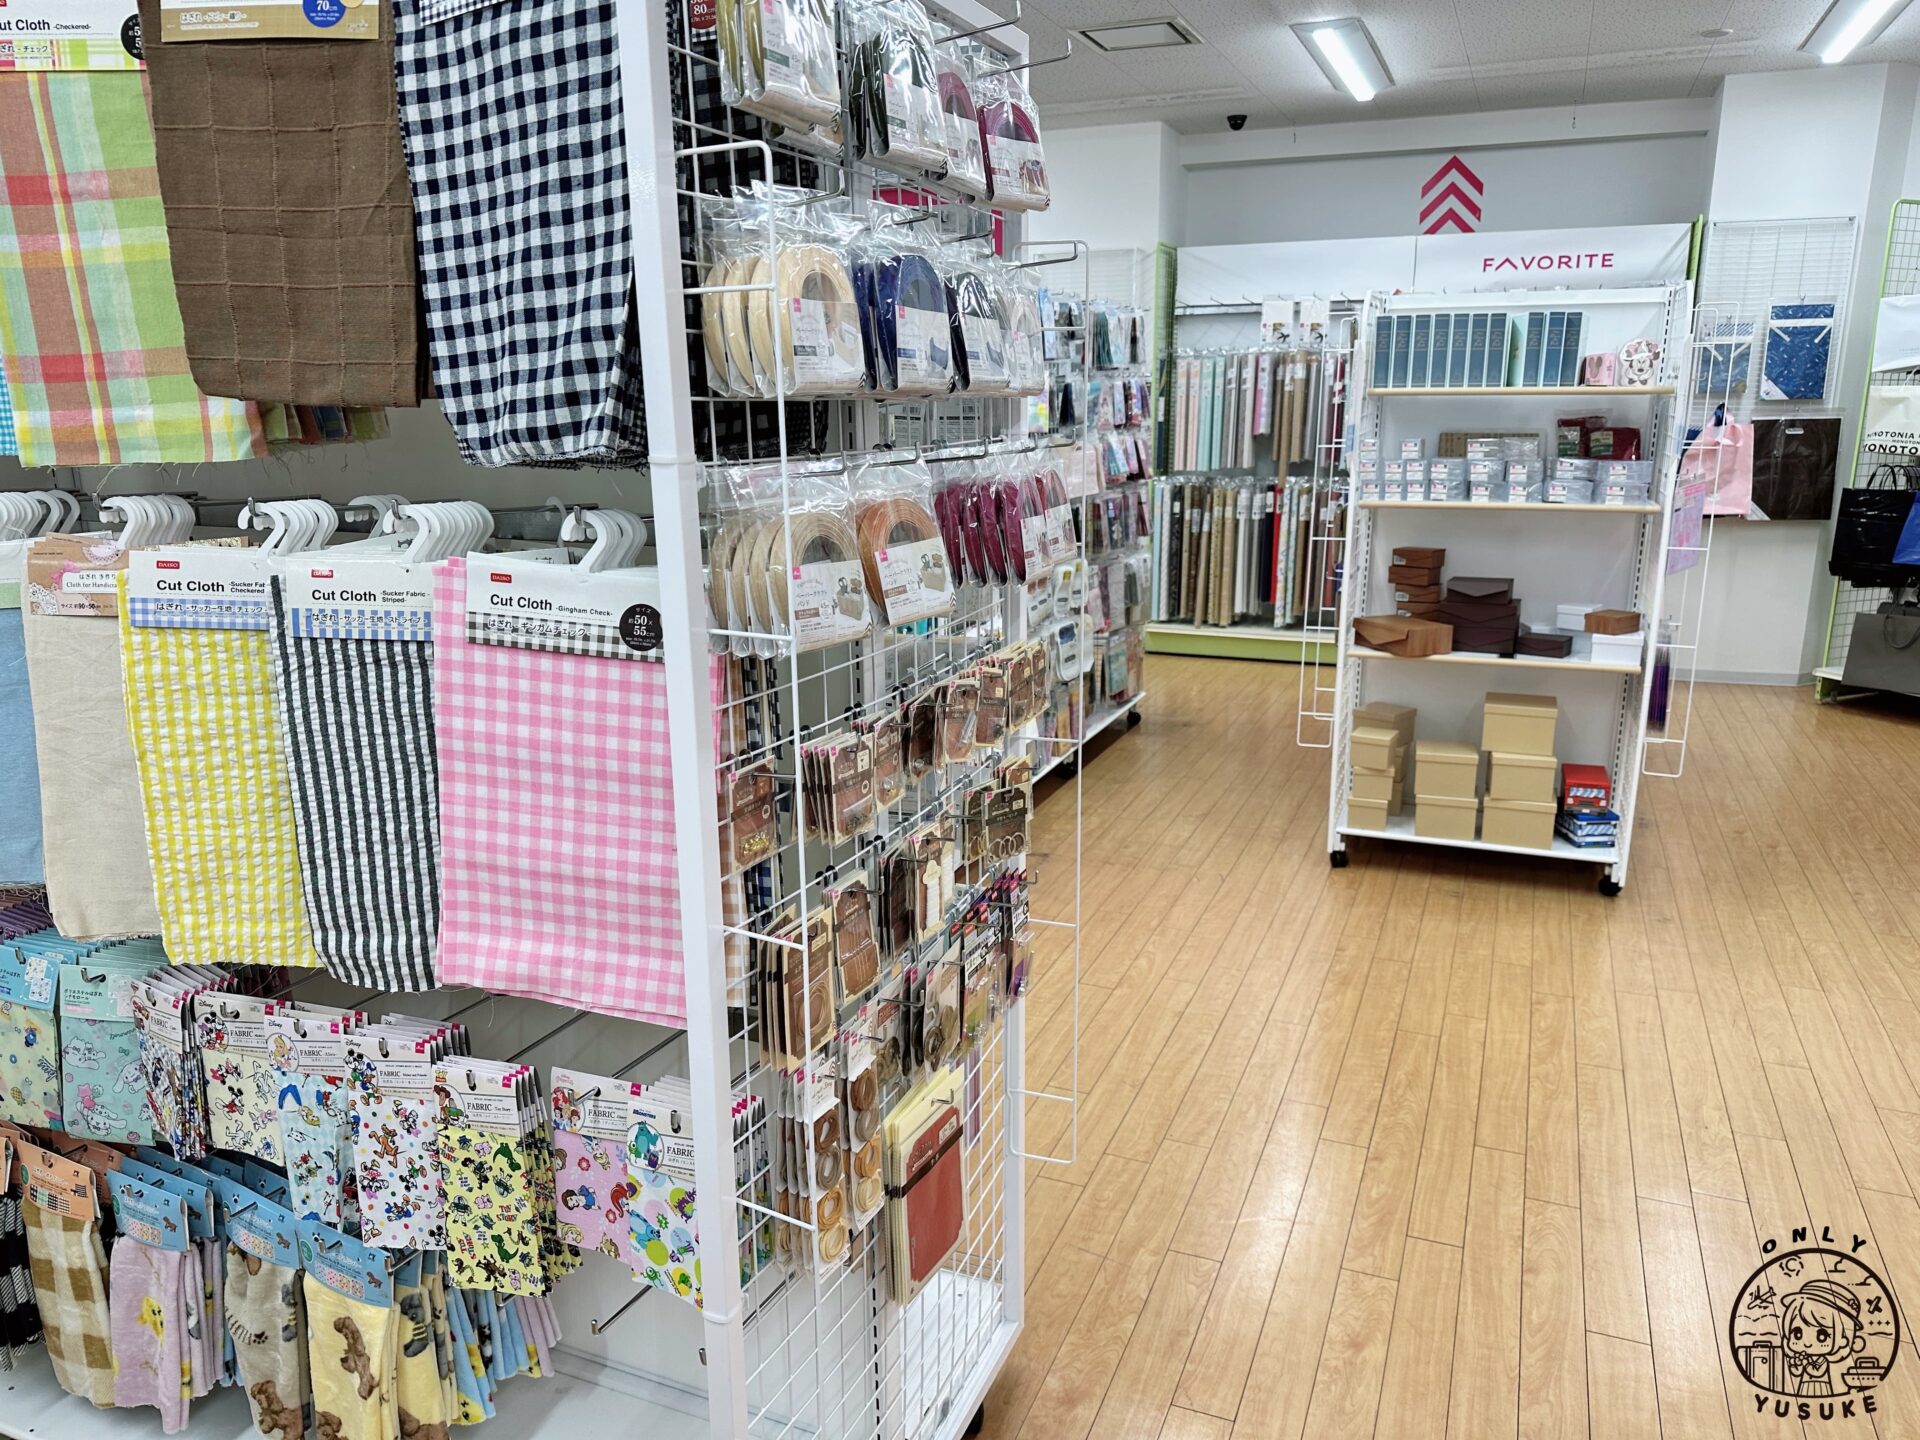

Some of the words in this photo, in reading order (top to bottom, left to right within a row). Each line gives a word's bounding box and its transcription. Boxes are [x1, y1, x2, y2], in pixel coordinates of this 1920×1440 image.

[15, 19, 51, 31] Cloth
[1483, 253, 1614, 272] FAVORITE
[156, 579, 183, 591] Cut
[186, 581, 225, 592] Cloth
[311, 589, 336, 601] Cut
[339, 590, 377, 602] Cloth
[156, 603, 183, 611] はぎれ
[490, 594, 513, 607] Cut
[517, 596, 552, 611] Cloth
[312, 613, 337, 622] はぎれ
[488, 618, 513, 629] はぎれ
[230, 1029, 253, 1038] FABRIC
[300, 1049, 323, 1057] FABRIC
[467, 1102, 492, 1112] FABRIC
[588, 1108, 616, 1119] FABRIC
[666, 1146, 695, 1158] FABRIC
